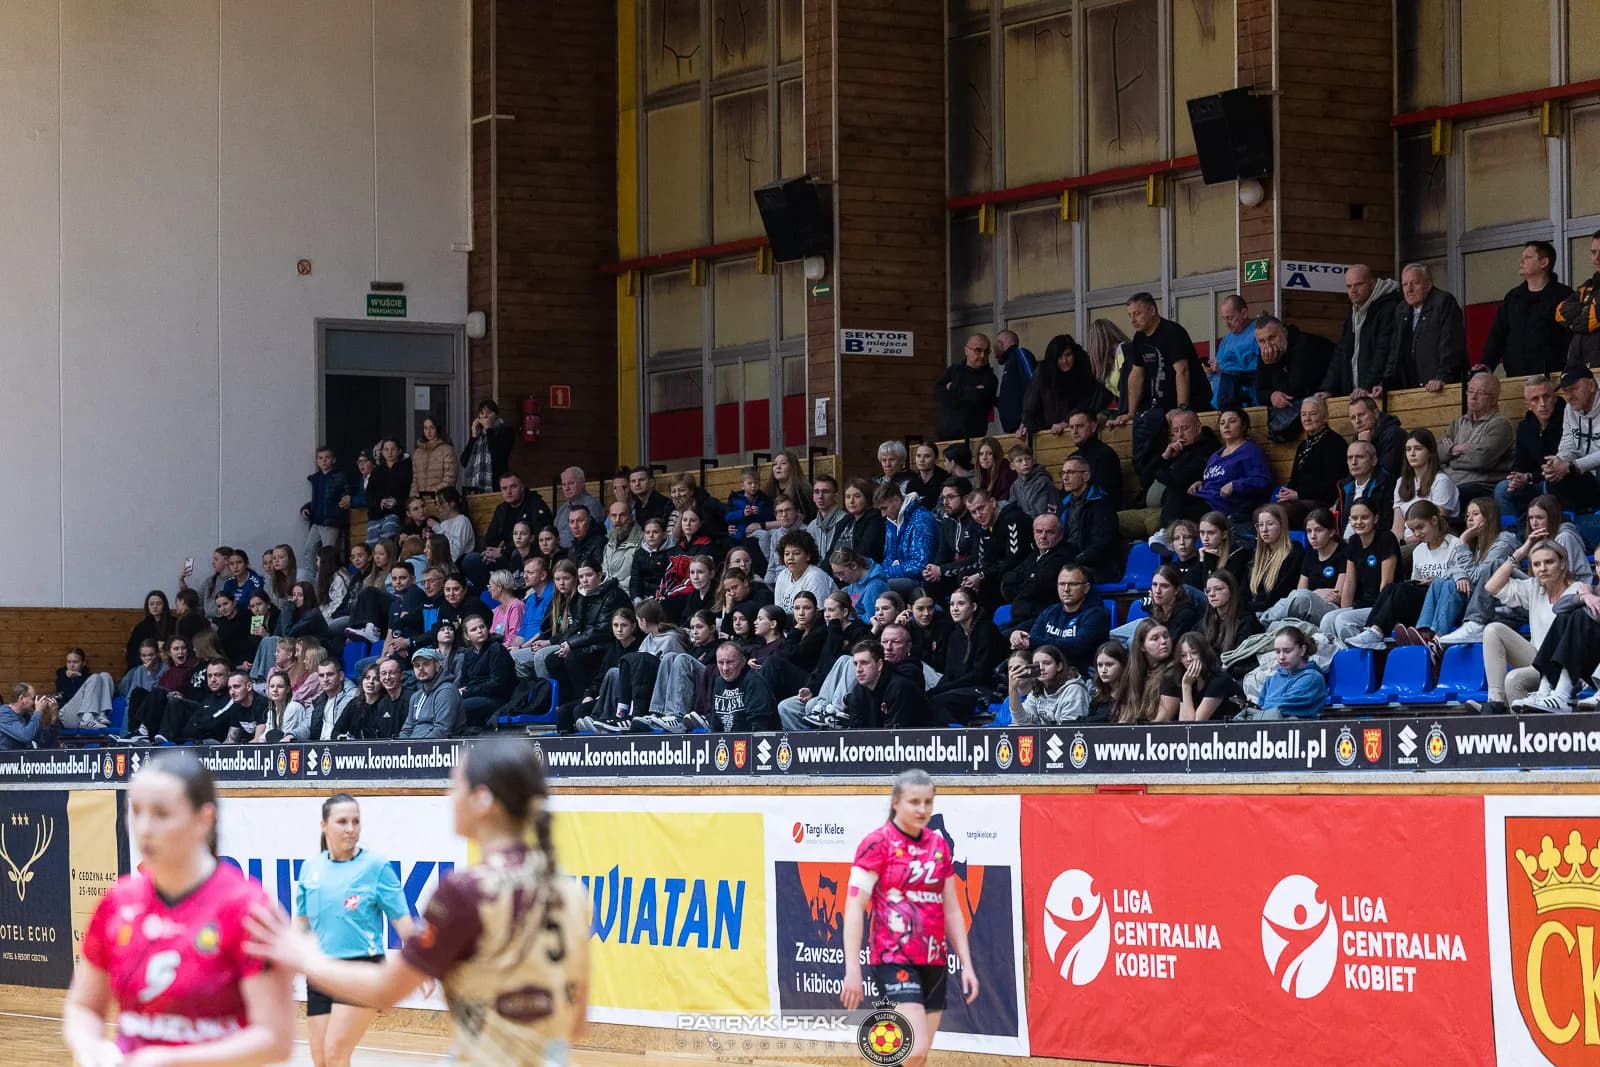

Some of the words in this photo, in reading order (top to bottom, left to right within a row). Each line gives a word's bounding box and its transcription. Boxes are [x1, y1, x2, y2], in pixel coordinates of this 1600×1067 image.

[1286, 272, 1311, 288] A
[845, 331, 908, 340] SEKTOR
[845, 339, 864, 352] B
[866, 340, 908, 348] miejsca
[1094, 728, 1327, 768] www.koronahandball.pl
[1455, 721, 1600, 754] www.korona
[199, 750, 273, 776] nahandball.pl
[335, 744, 459, 770] www.koronahandball
[547, 740, 710, 772] www.koronahandball.pl
[797, 735, 989, 771] www.koronahandball.pl
[805, 823, 823, 838] Targi
[824, 823, 845, 835] Kielce
[79, 871, 104, 881] CEDZYNA
[908, 860, 939, 884] 32
[569, 864, 746, 950] WIATAN
[1113, 889, 1152, 914] LIGA
[1341, 895, 1388, 923] LIGA
[0, 924, 24, 941] OTEL
[28, 925, 56, 942] ECHO
[1114, 921, 1222, 949] CENTRALNA
[1342, 930, 1468, 962] CENTRALNA
[795, 942, 844, 964] Zawsze
[860, 946, 871, 965] st
[1115, 952, 1177, 979] KOBIET
[796, 971, 801, 992] i
[1344, 963, 1417, 992] KOBIET
